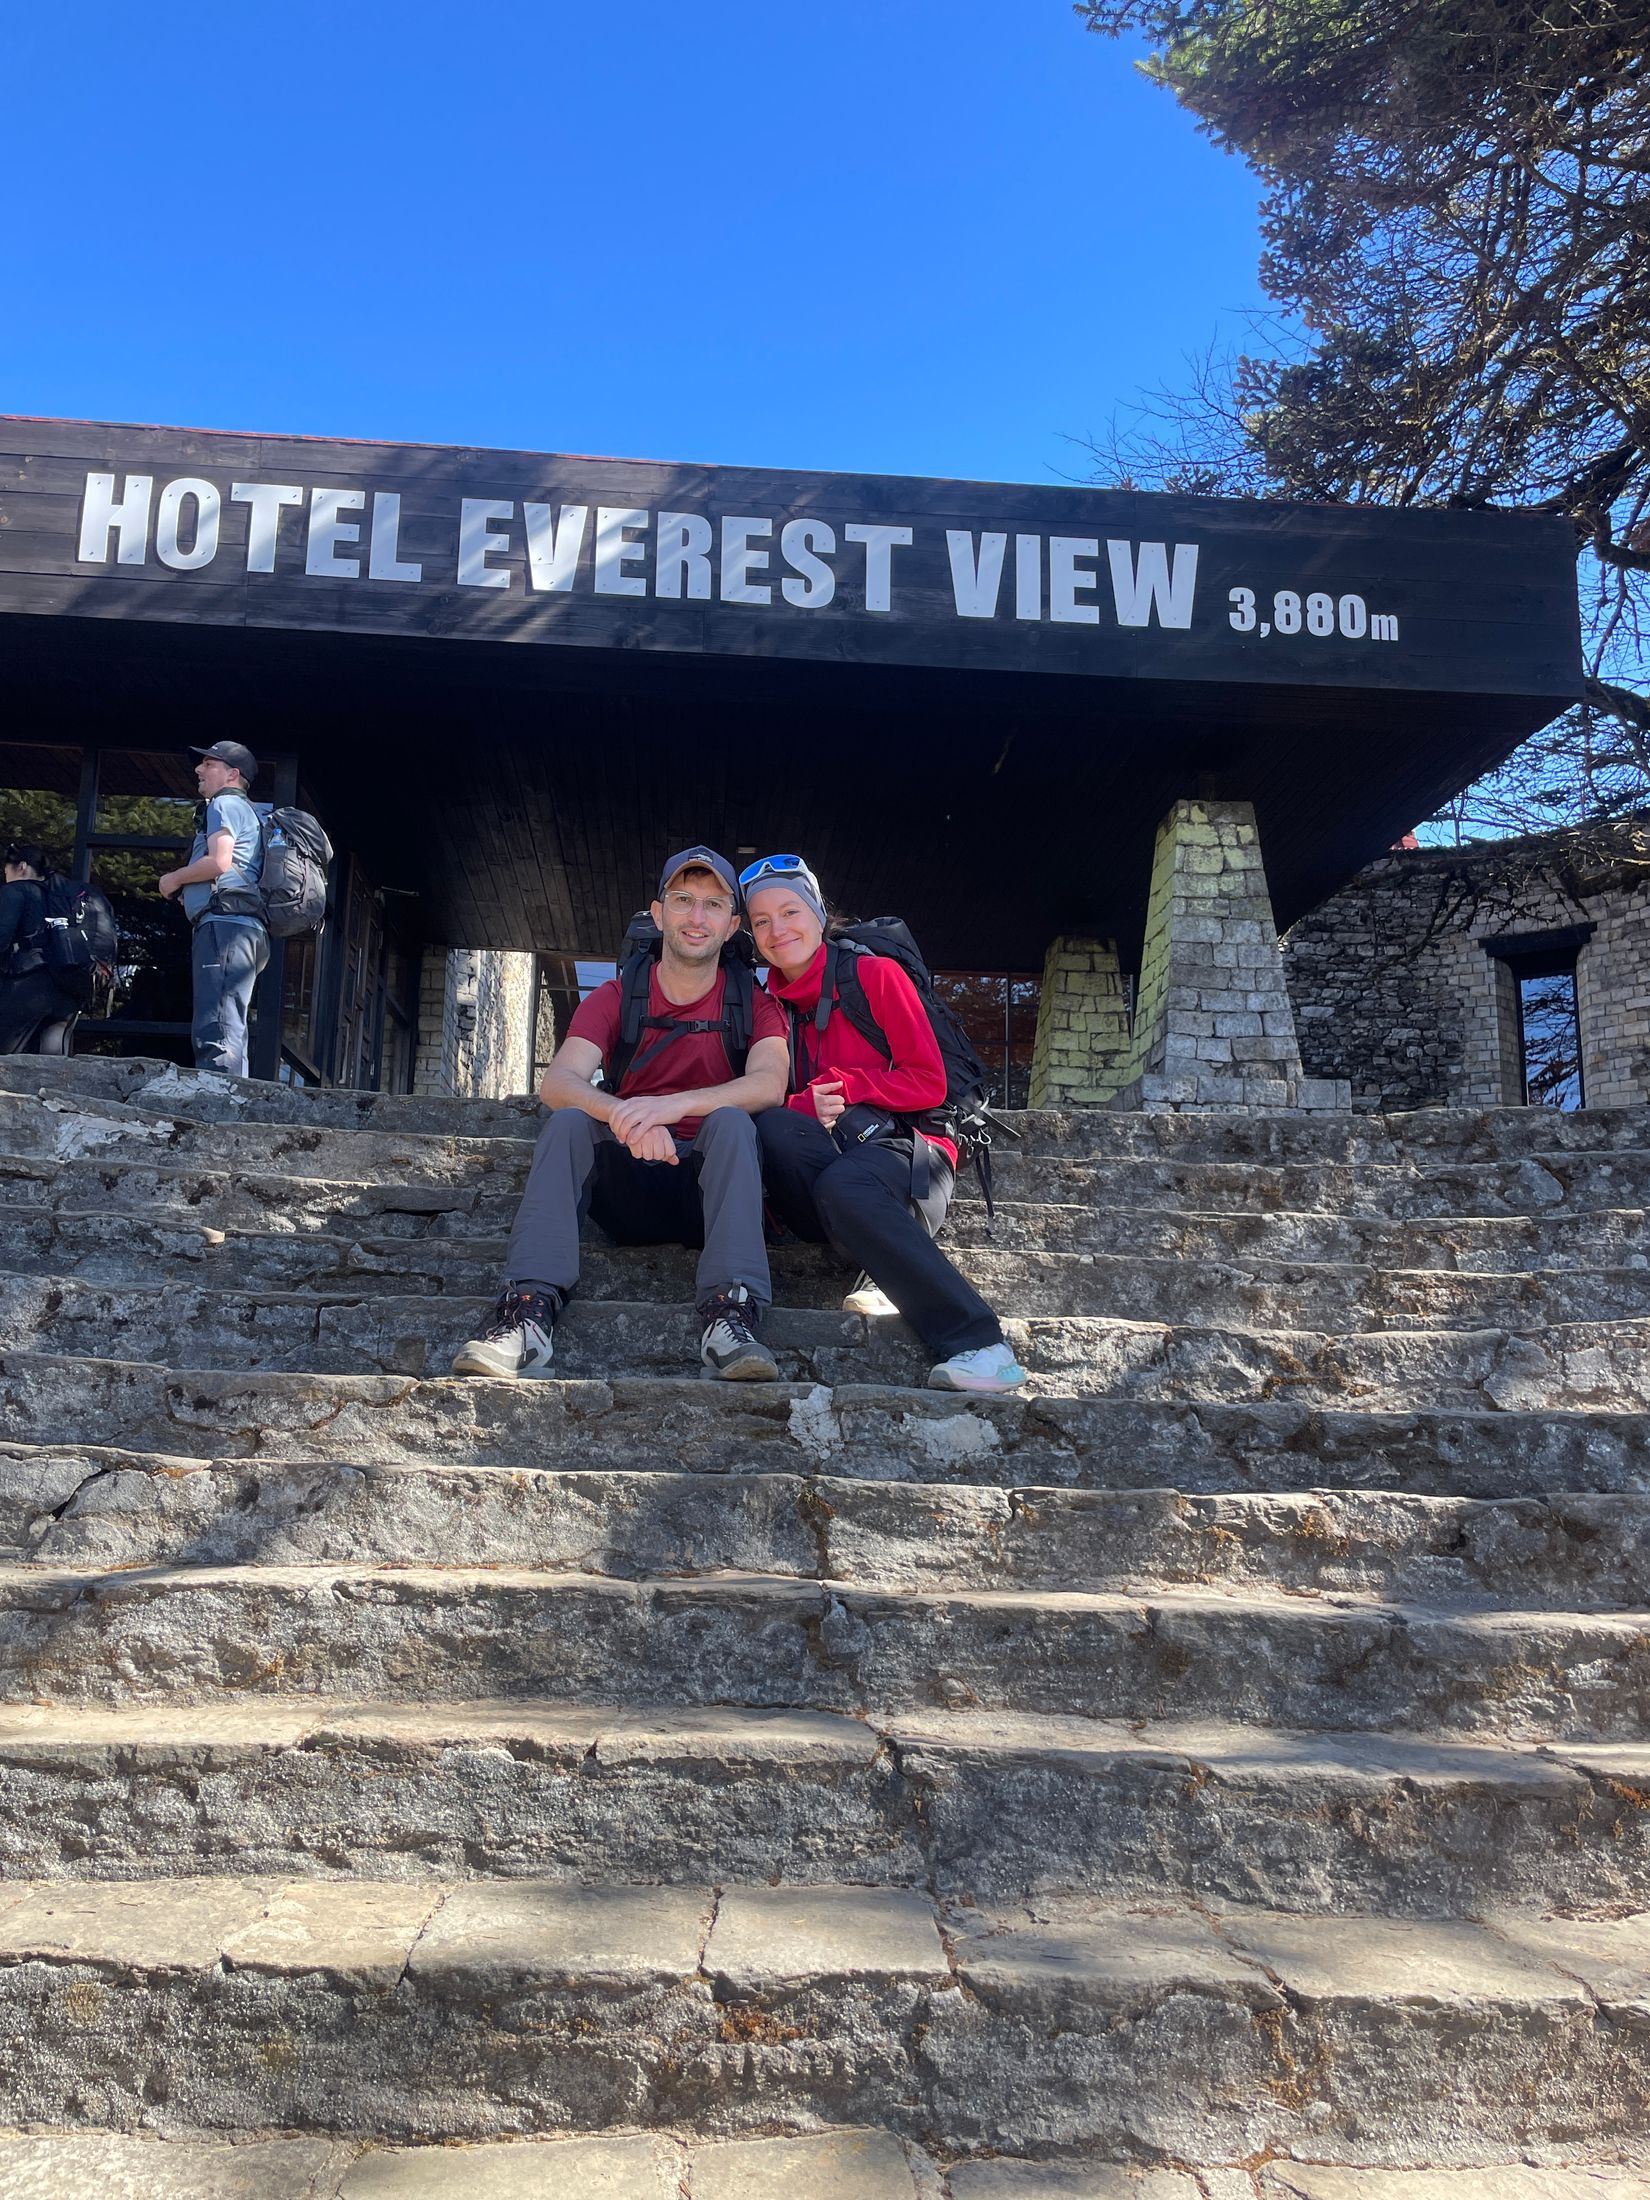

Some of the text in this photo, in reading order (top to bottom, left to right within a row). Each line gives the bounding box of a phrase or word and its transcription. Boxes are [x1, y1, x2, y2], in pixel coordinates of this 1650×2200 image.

[78, 472, 1399, 641] HOTEL EVEREST VIEW 3,880m
